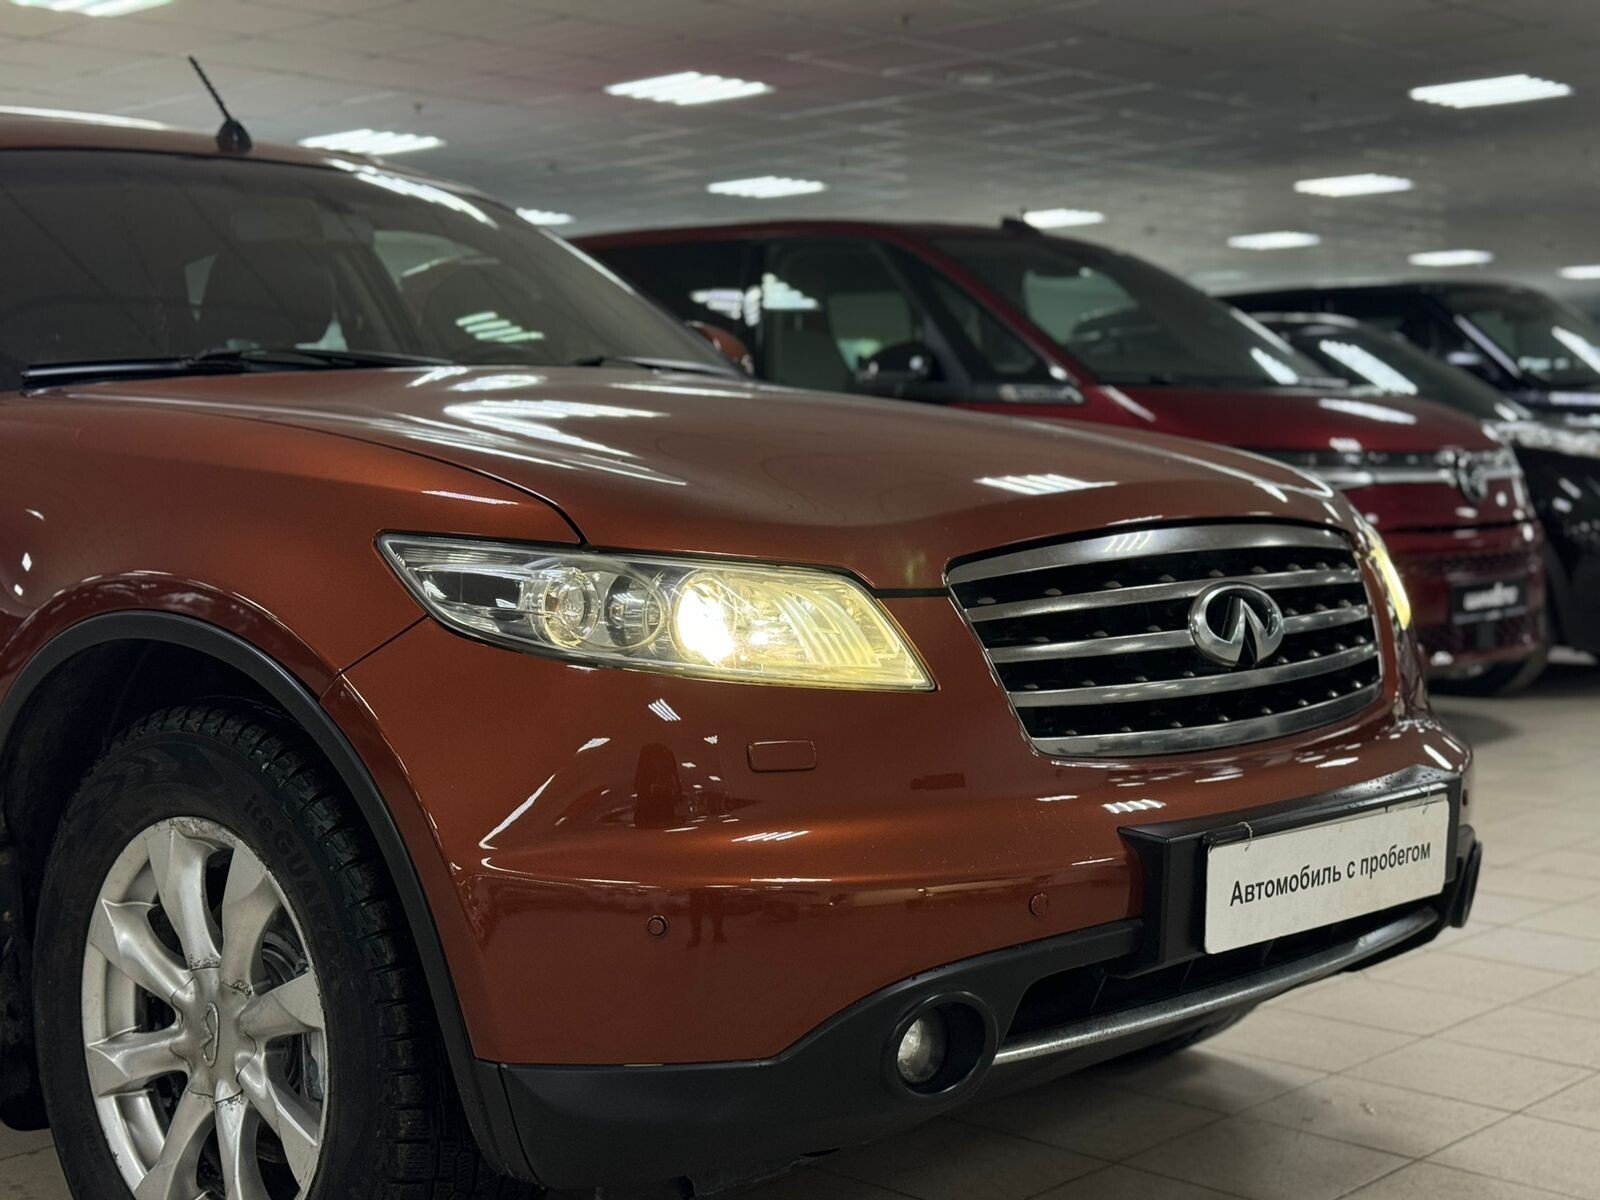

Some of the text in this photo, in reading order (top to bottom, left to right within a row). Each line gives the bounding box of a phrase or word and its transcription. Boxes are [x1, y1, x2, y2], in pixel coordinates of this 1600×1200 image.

[1229, 842, 1431, 907] Автомобиль с пробегом
